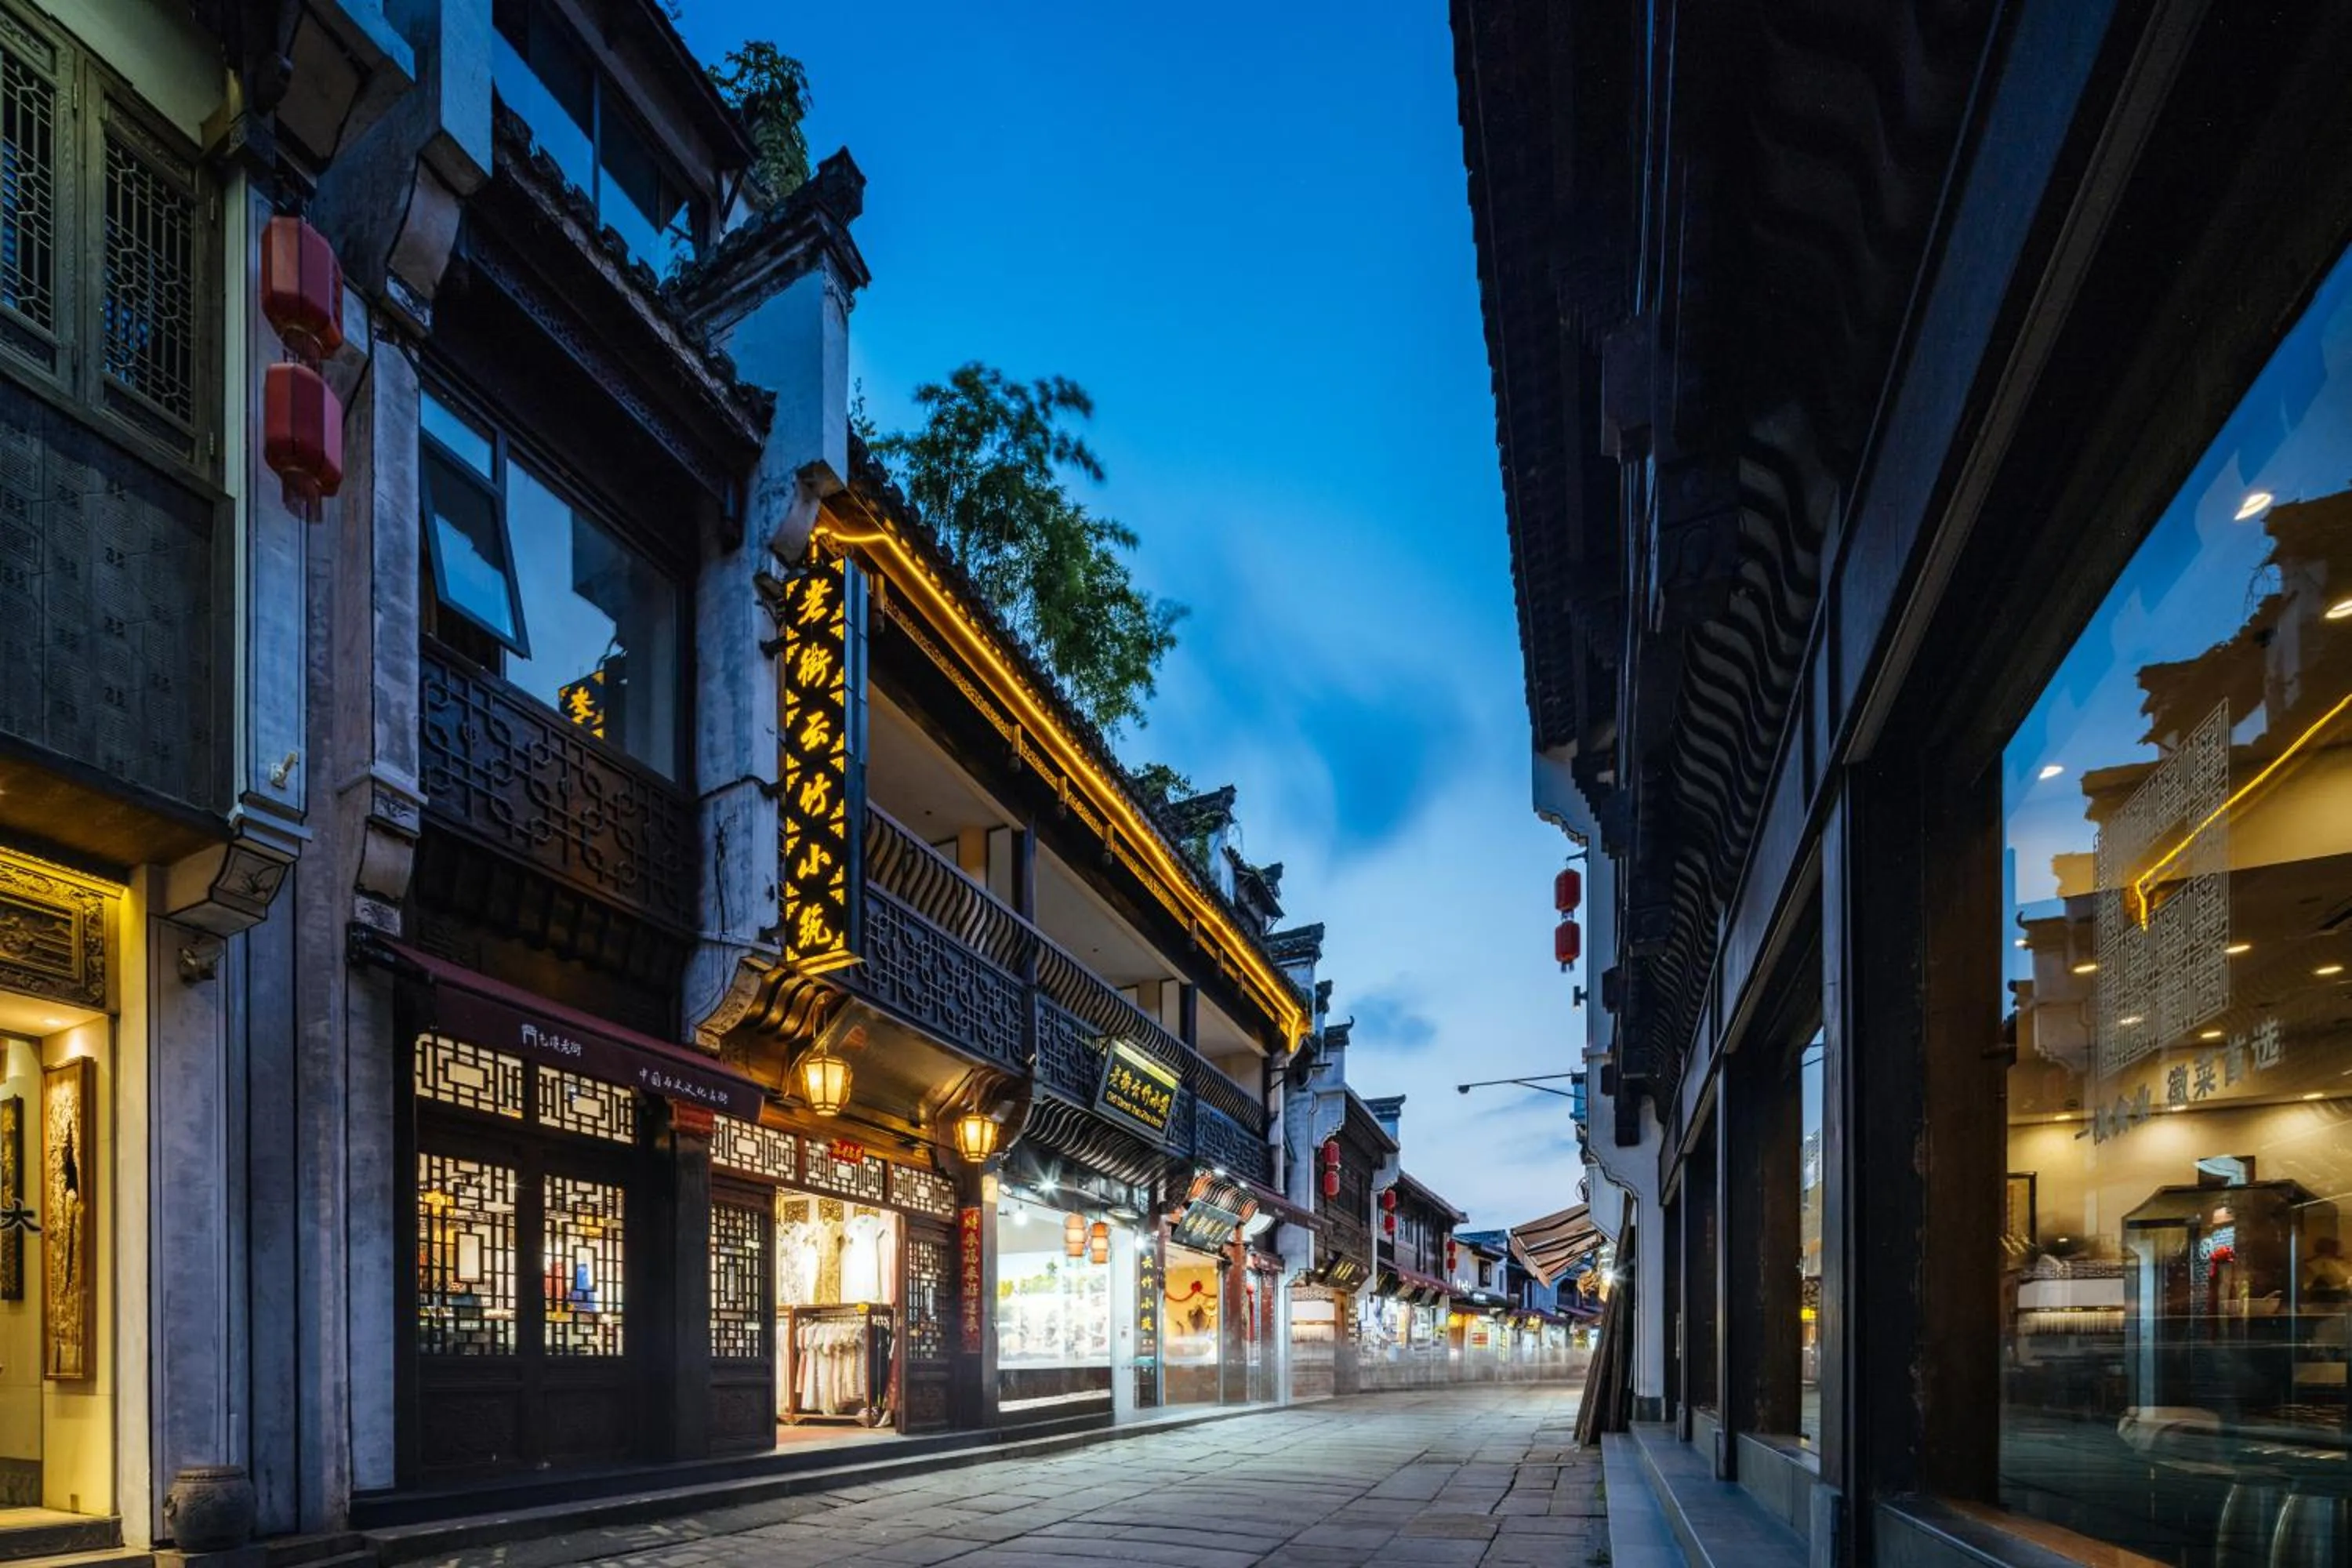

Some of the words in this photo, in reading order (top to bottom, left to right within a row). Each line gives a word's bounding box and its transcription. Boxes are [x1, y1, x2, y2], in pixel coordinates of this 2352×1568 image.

[797, 578, 833, 949] 老街云竹小筑
